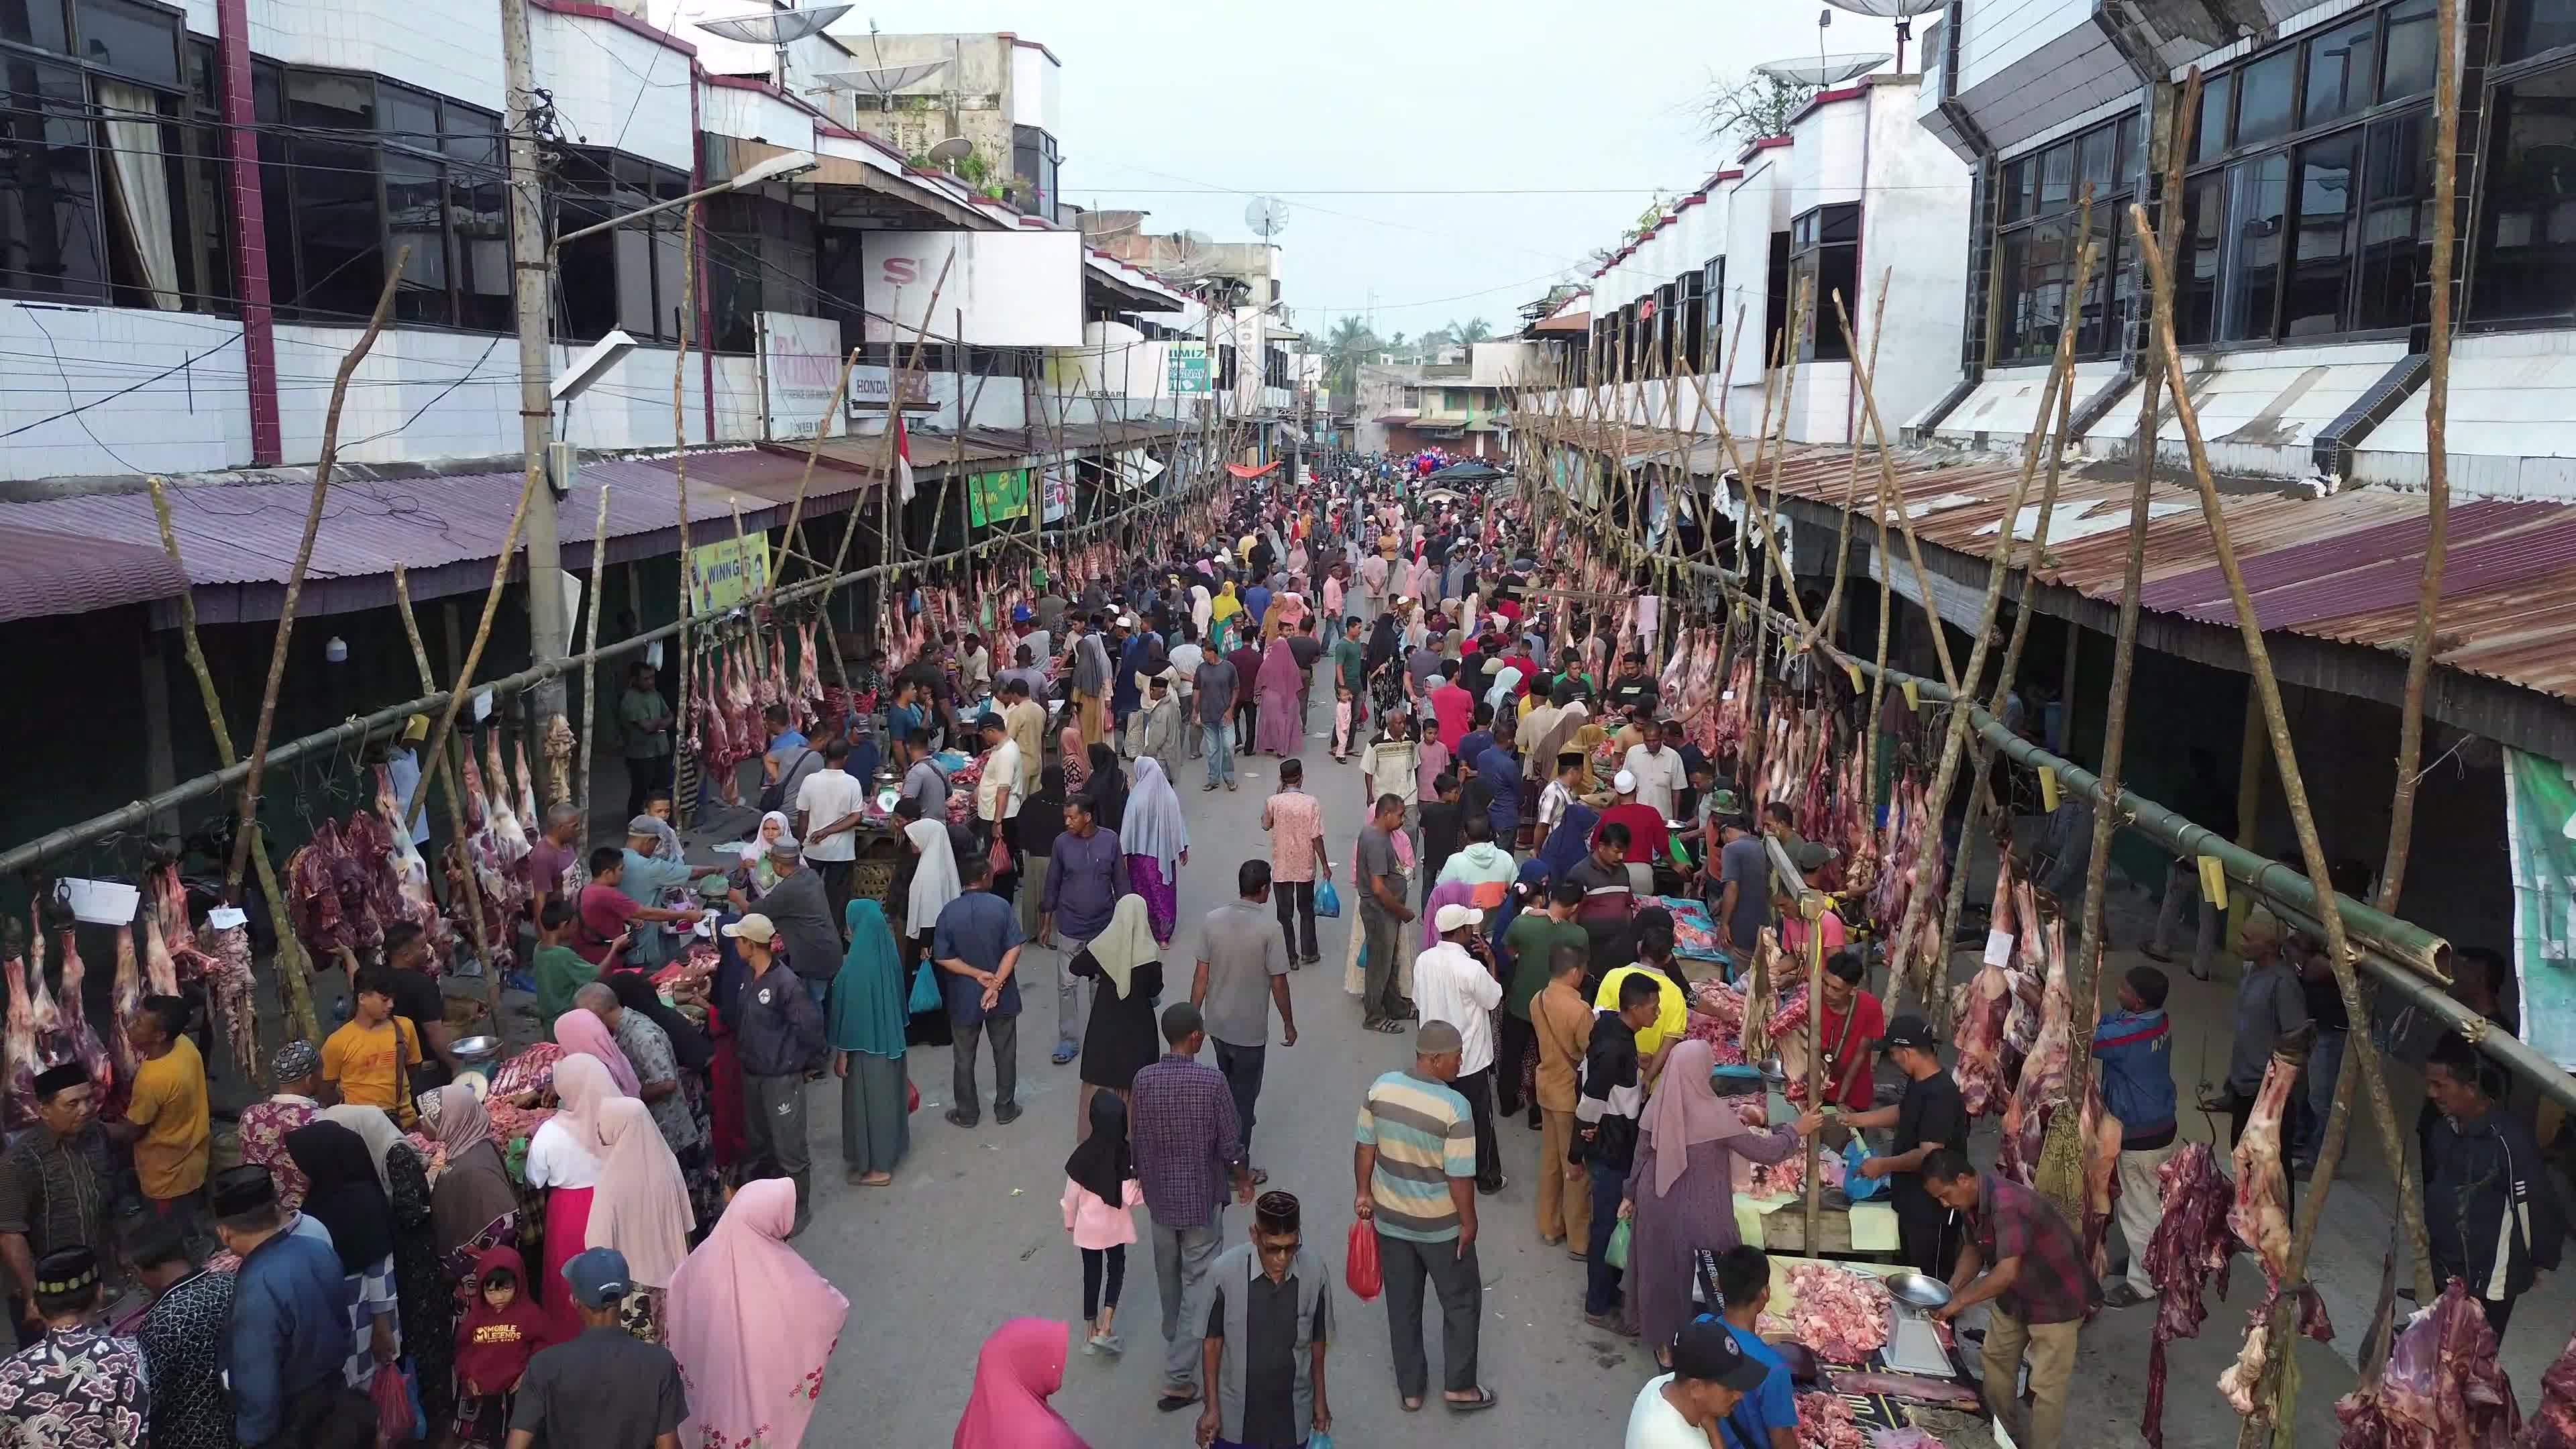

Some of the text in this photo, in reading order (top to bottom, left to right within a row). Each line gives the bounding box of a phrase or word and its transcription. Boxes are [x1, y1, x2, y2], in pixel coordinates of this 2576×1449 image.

[857, 380, 888, 394] HONDA
[487, 1324, 517, 1332] MOBILE
[487, 1332, 521, 1340] LEGENDS
